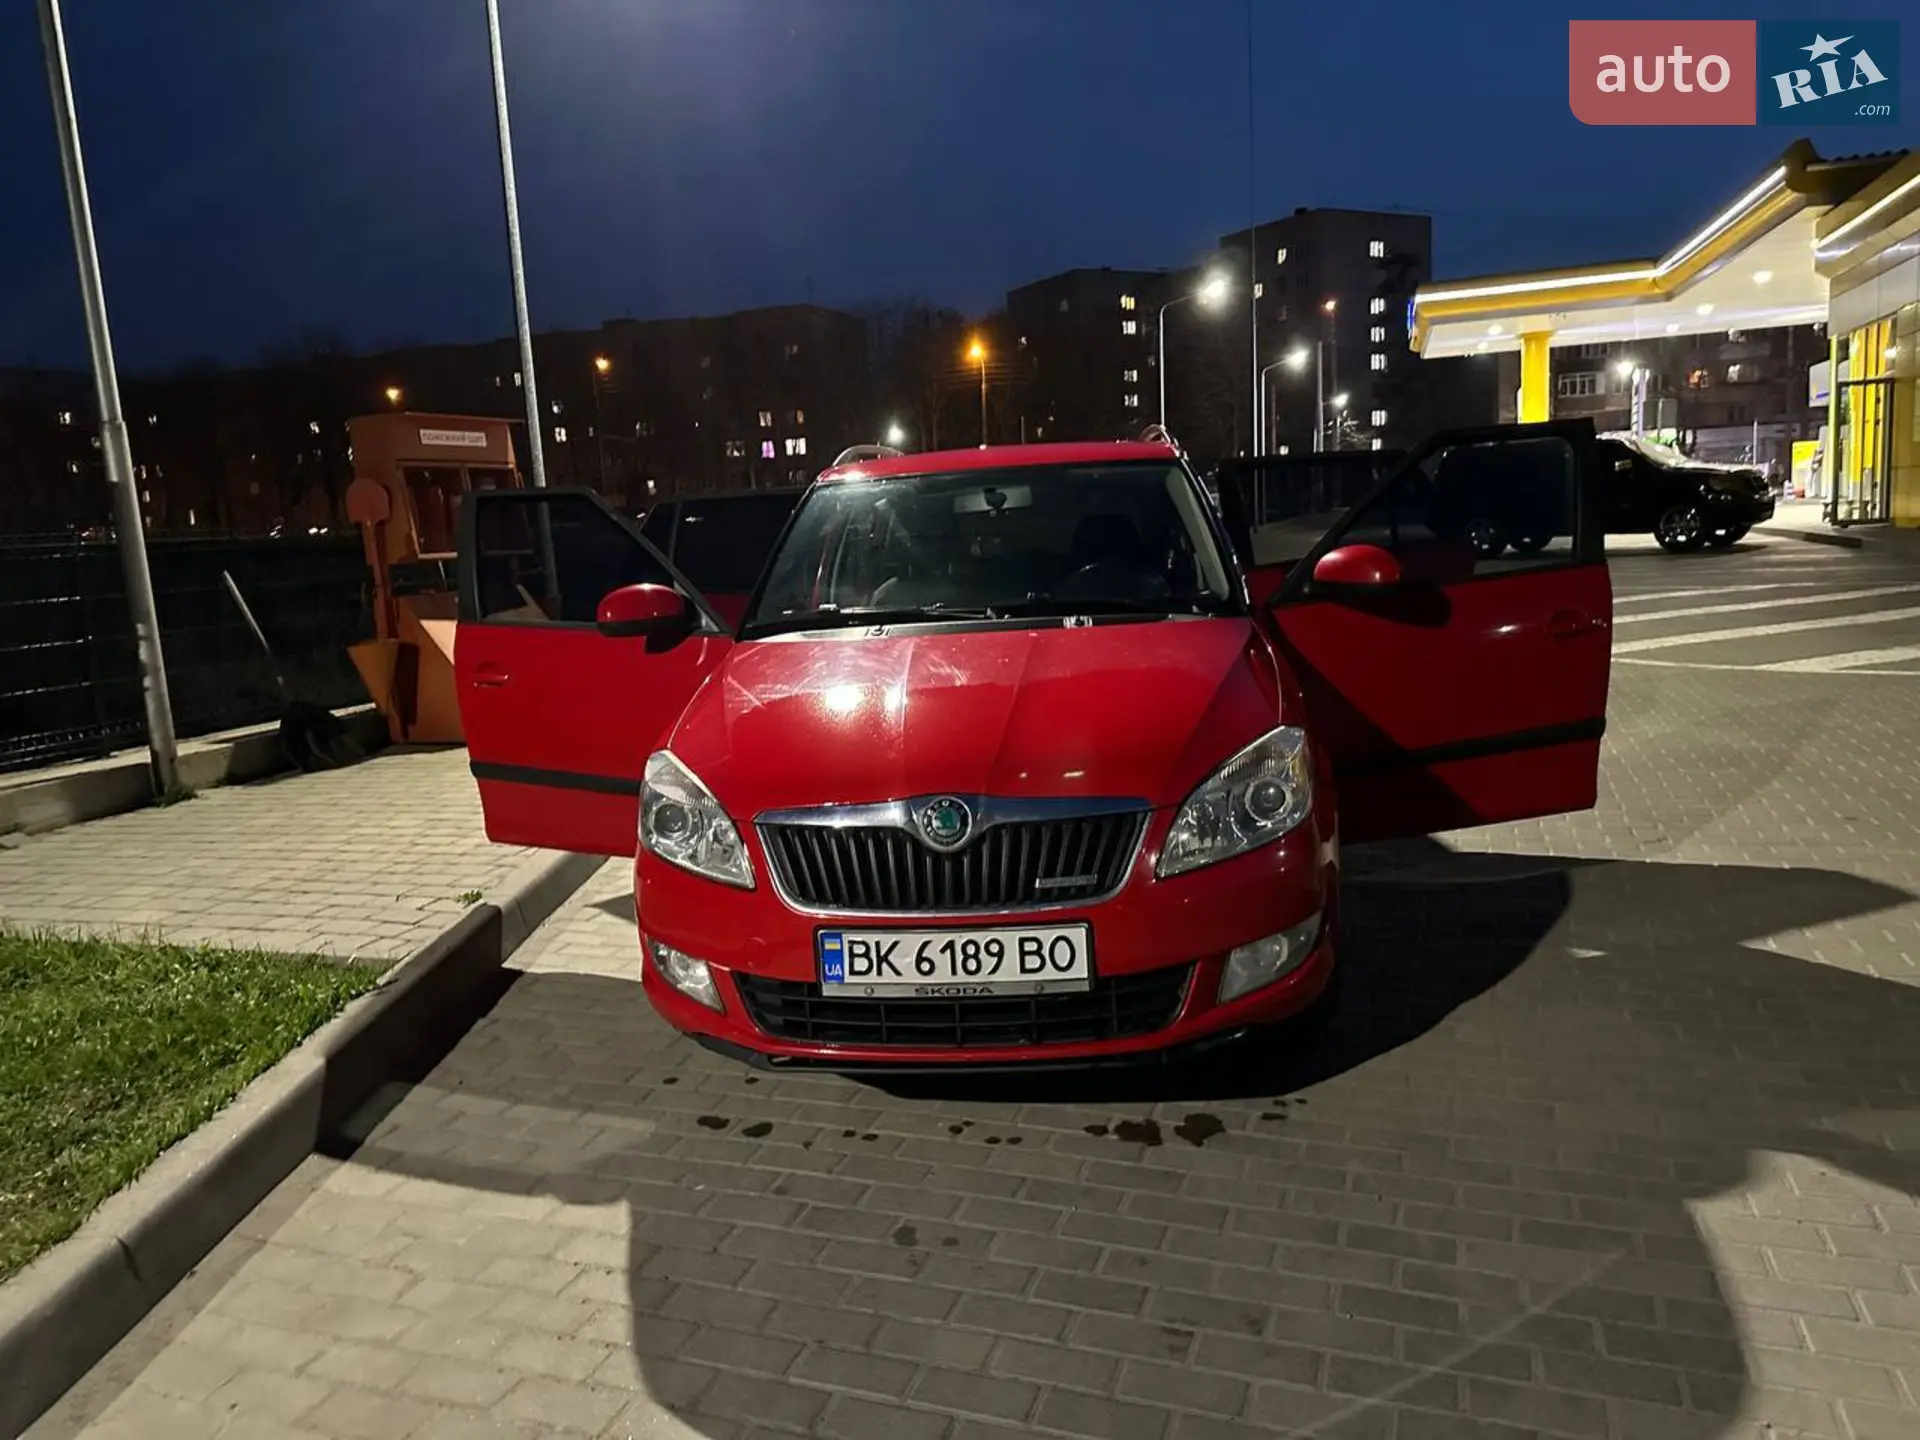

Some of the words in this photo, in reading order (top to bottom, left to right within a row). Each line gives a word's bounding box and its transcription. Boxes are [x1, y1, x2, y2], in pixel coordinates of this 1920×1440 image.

[825, 963, 842, 976] UA
[847, 939, 903, 977] BK
[915, 938, 1005, 977] 6189
[1018, 934, 1077, 974] BO
